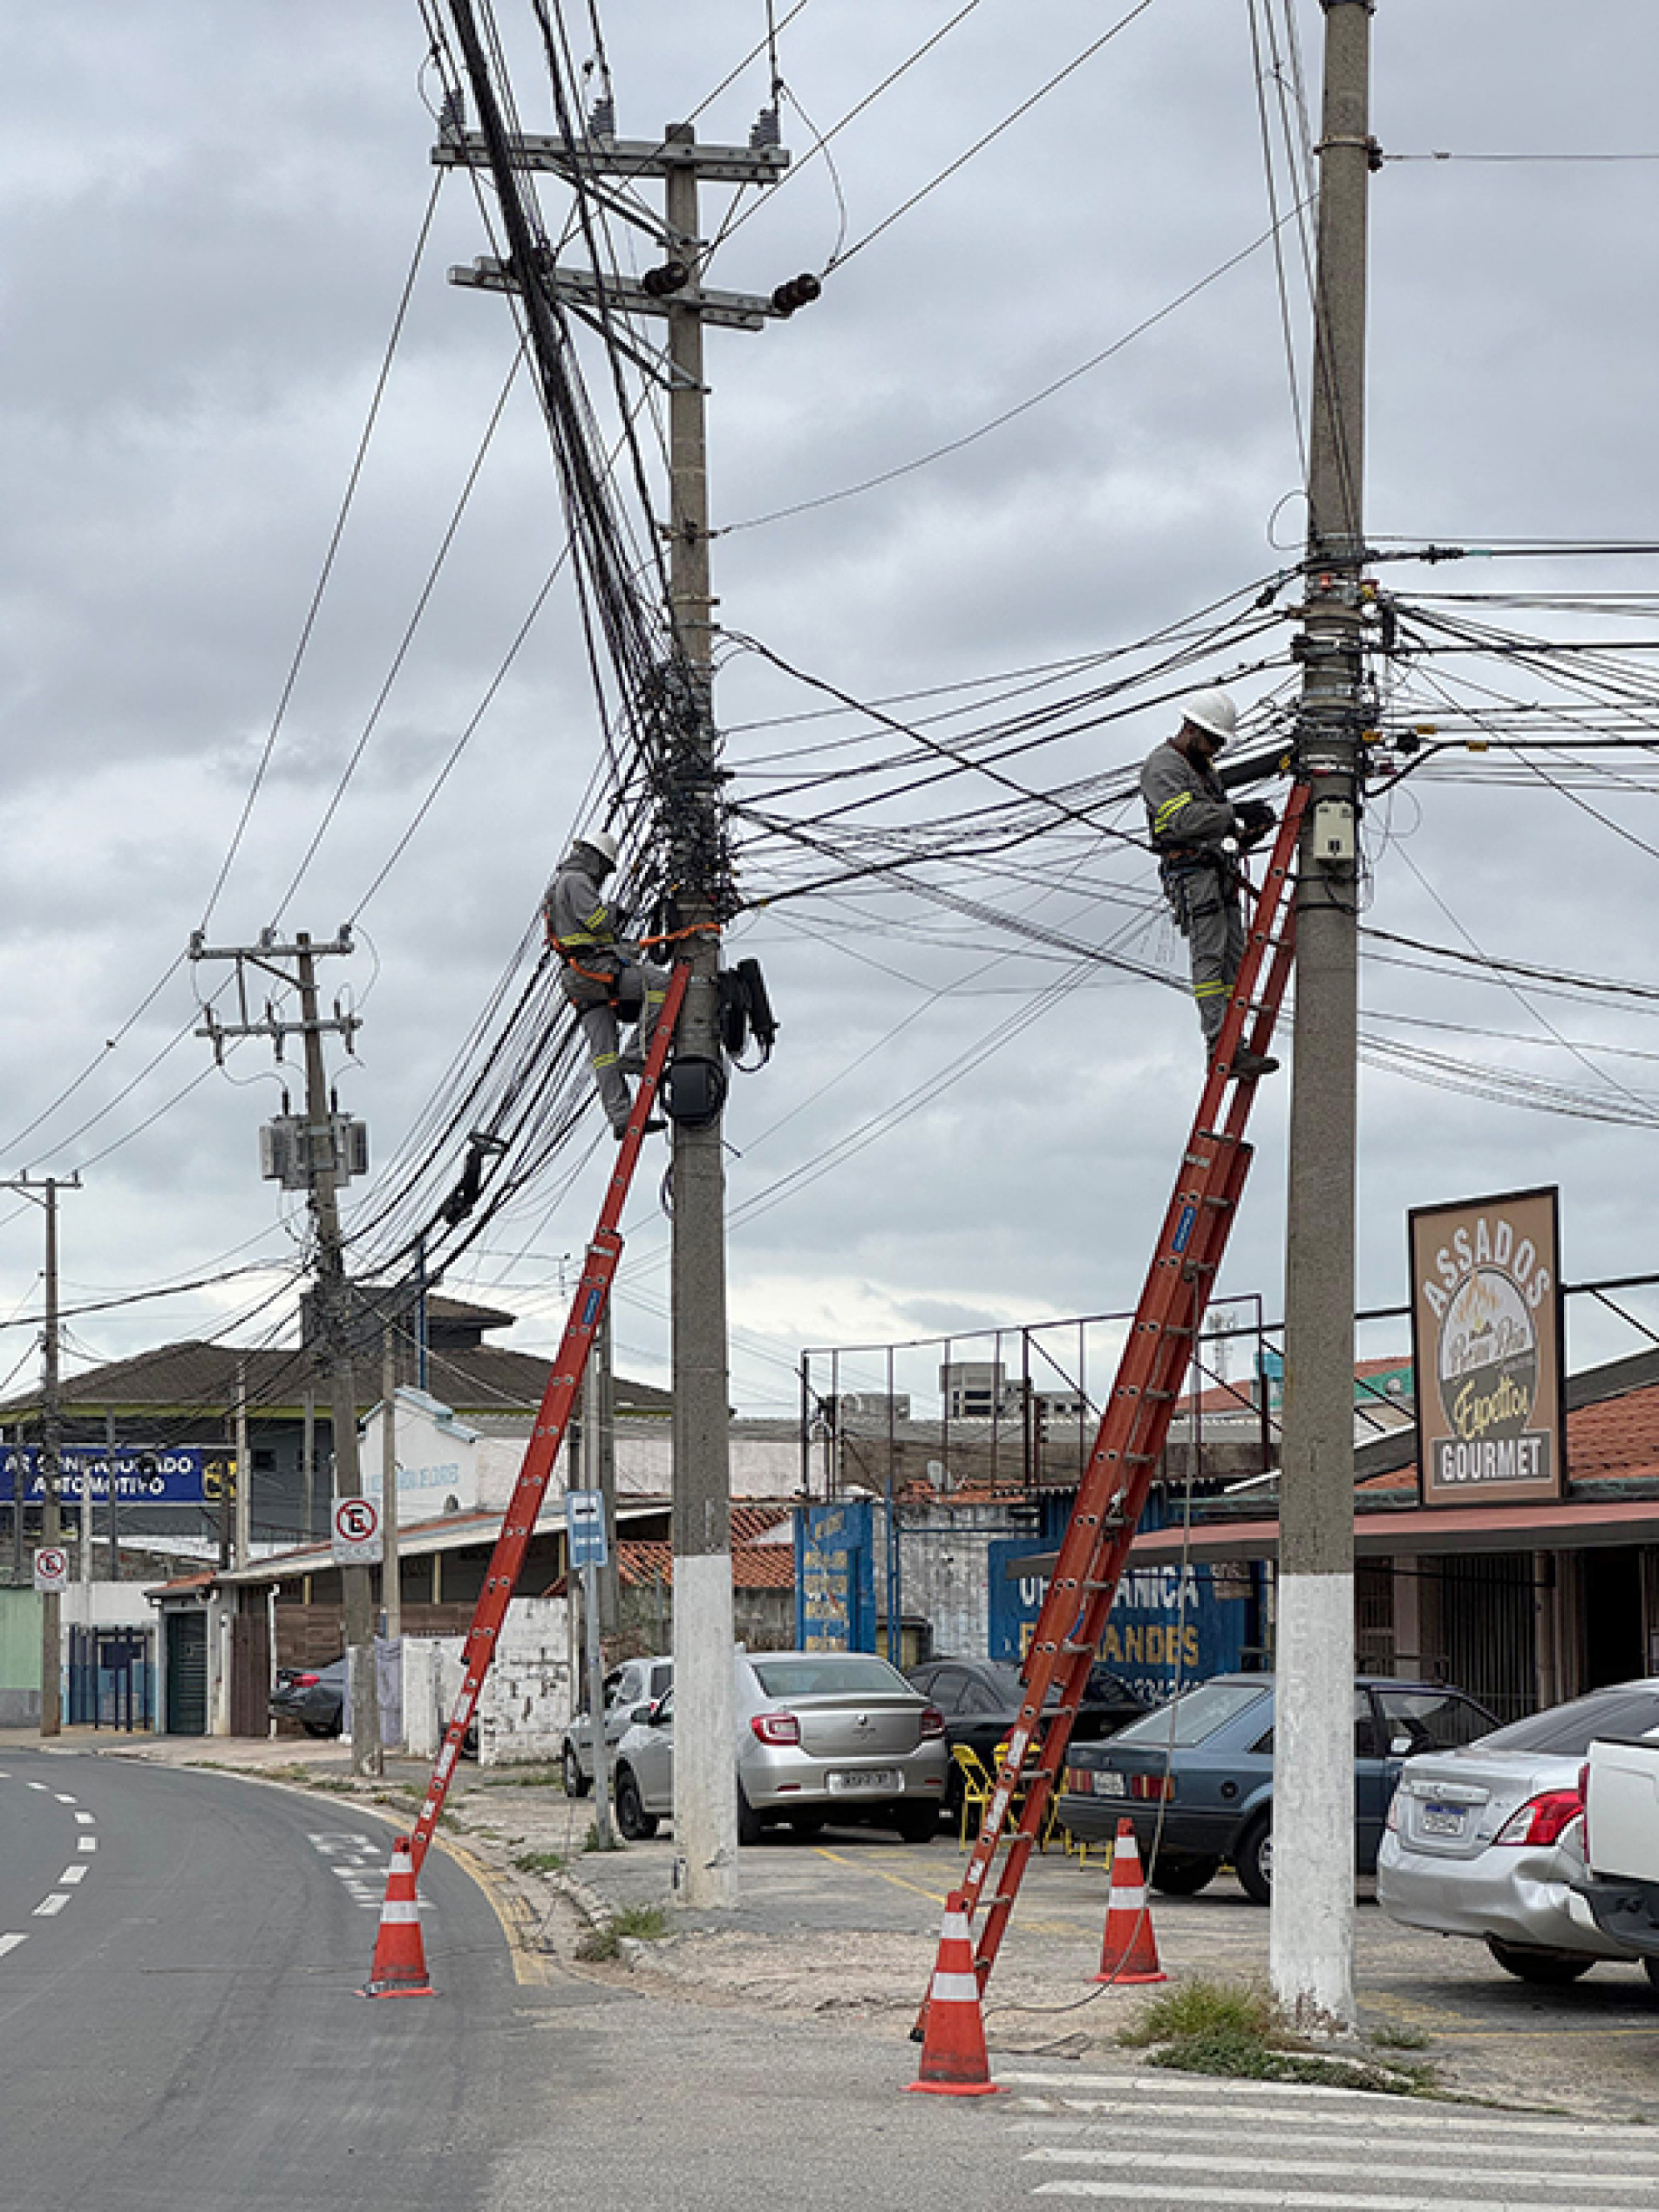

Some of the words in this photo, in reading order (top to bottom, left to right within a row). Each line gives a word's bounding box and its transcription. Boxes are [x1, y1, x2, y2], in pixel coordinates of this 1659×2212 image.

[1423, 1218, 1550, 1318] ASSADOS
[1441, 1437, 1541, 1481] GOURMET
[31, 1476, 165, 1495] ATOMTIVO
[1019, 1622, 1199, 1667] FANDES
